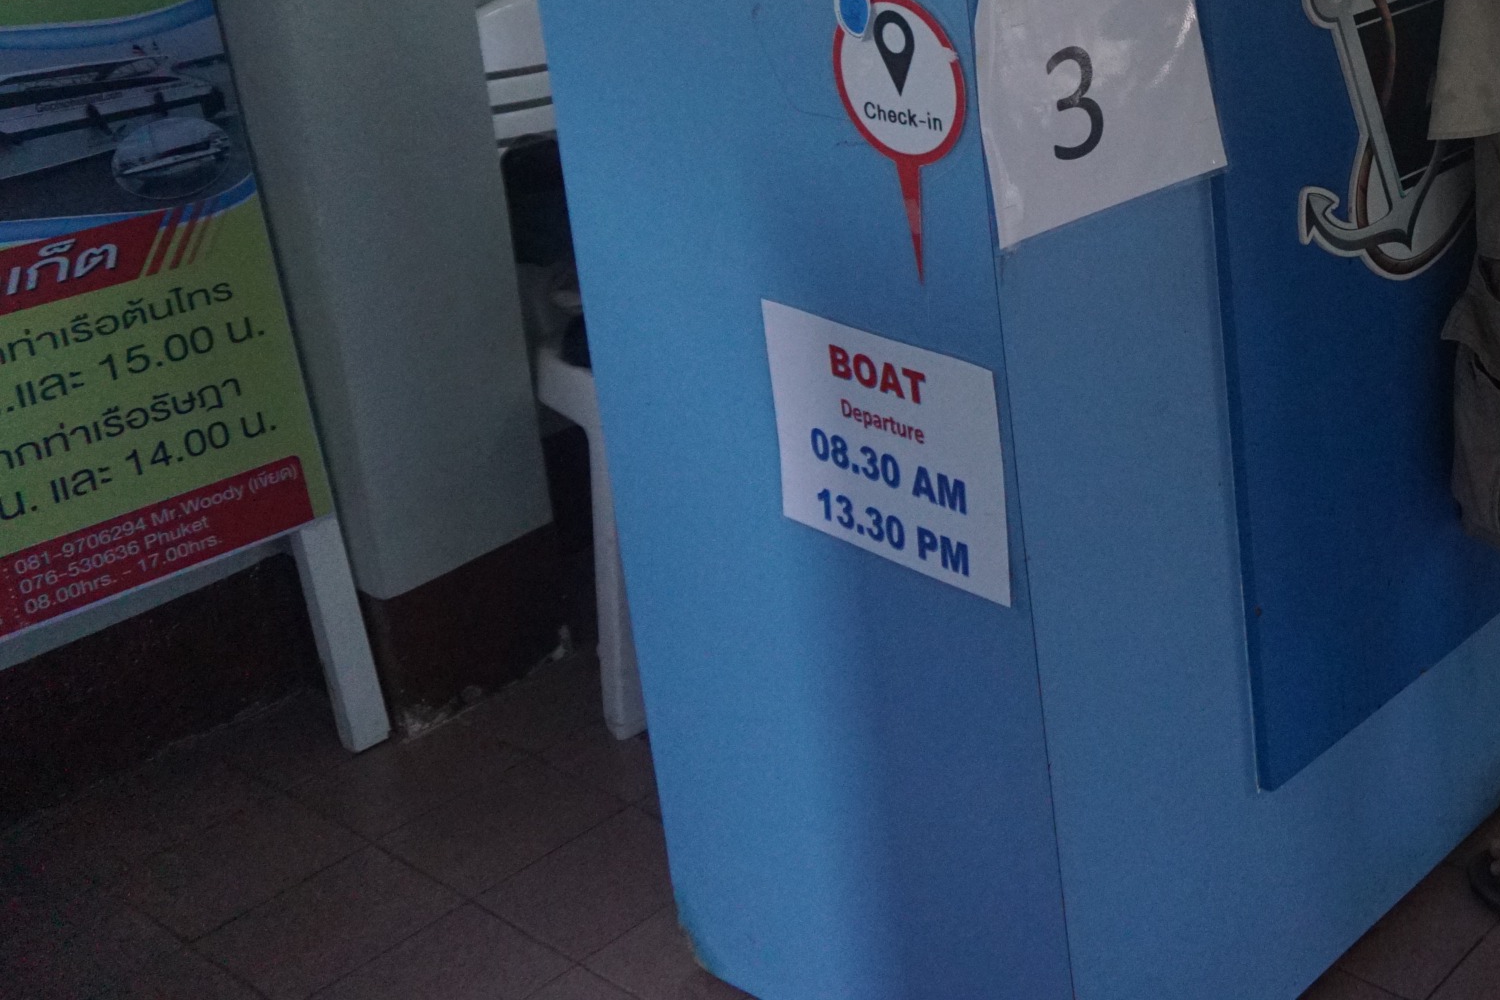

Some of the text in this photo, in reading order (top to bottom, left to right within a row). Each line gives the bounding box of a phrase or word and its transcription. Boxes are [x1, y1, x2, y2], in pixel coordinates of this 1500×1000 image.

[863, 101, 943, 132] Check-in
[1046, 45, 1104, 160] 3
[98, 325, 215, 383] 15.00
[225, 316, 266, 345] น.
[829, 343, 926, 404] BOAT
[50, 465, 113, 505] และ
[124, 420, 231, 477] 14.00
[240, 410, 279, 440] น.
[840, 398, 925, 445] Departure
[810, 426, 967, 515] 08.30 AM
[13, 517, 148, 576] 081-9706294
[150, 483, 245, 528] Mr.Woody
[18, 514, 210, 596] 076-530636 Phuket
[817, 489, 970, 578] 13.30 PM
[24, 574, 118, 616] 08.00hrs.
[137, 532, 224, 574] 17.00hrs.
